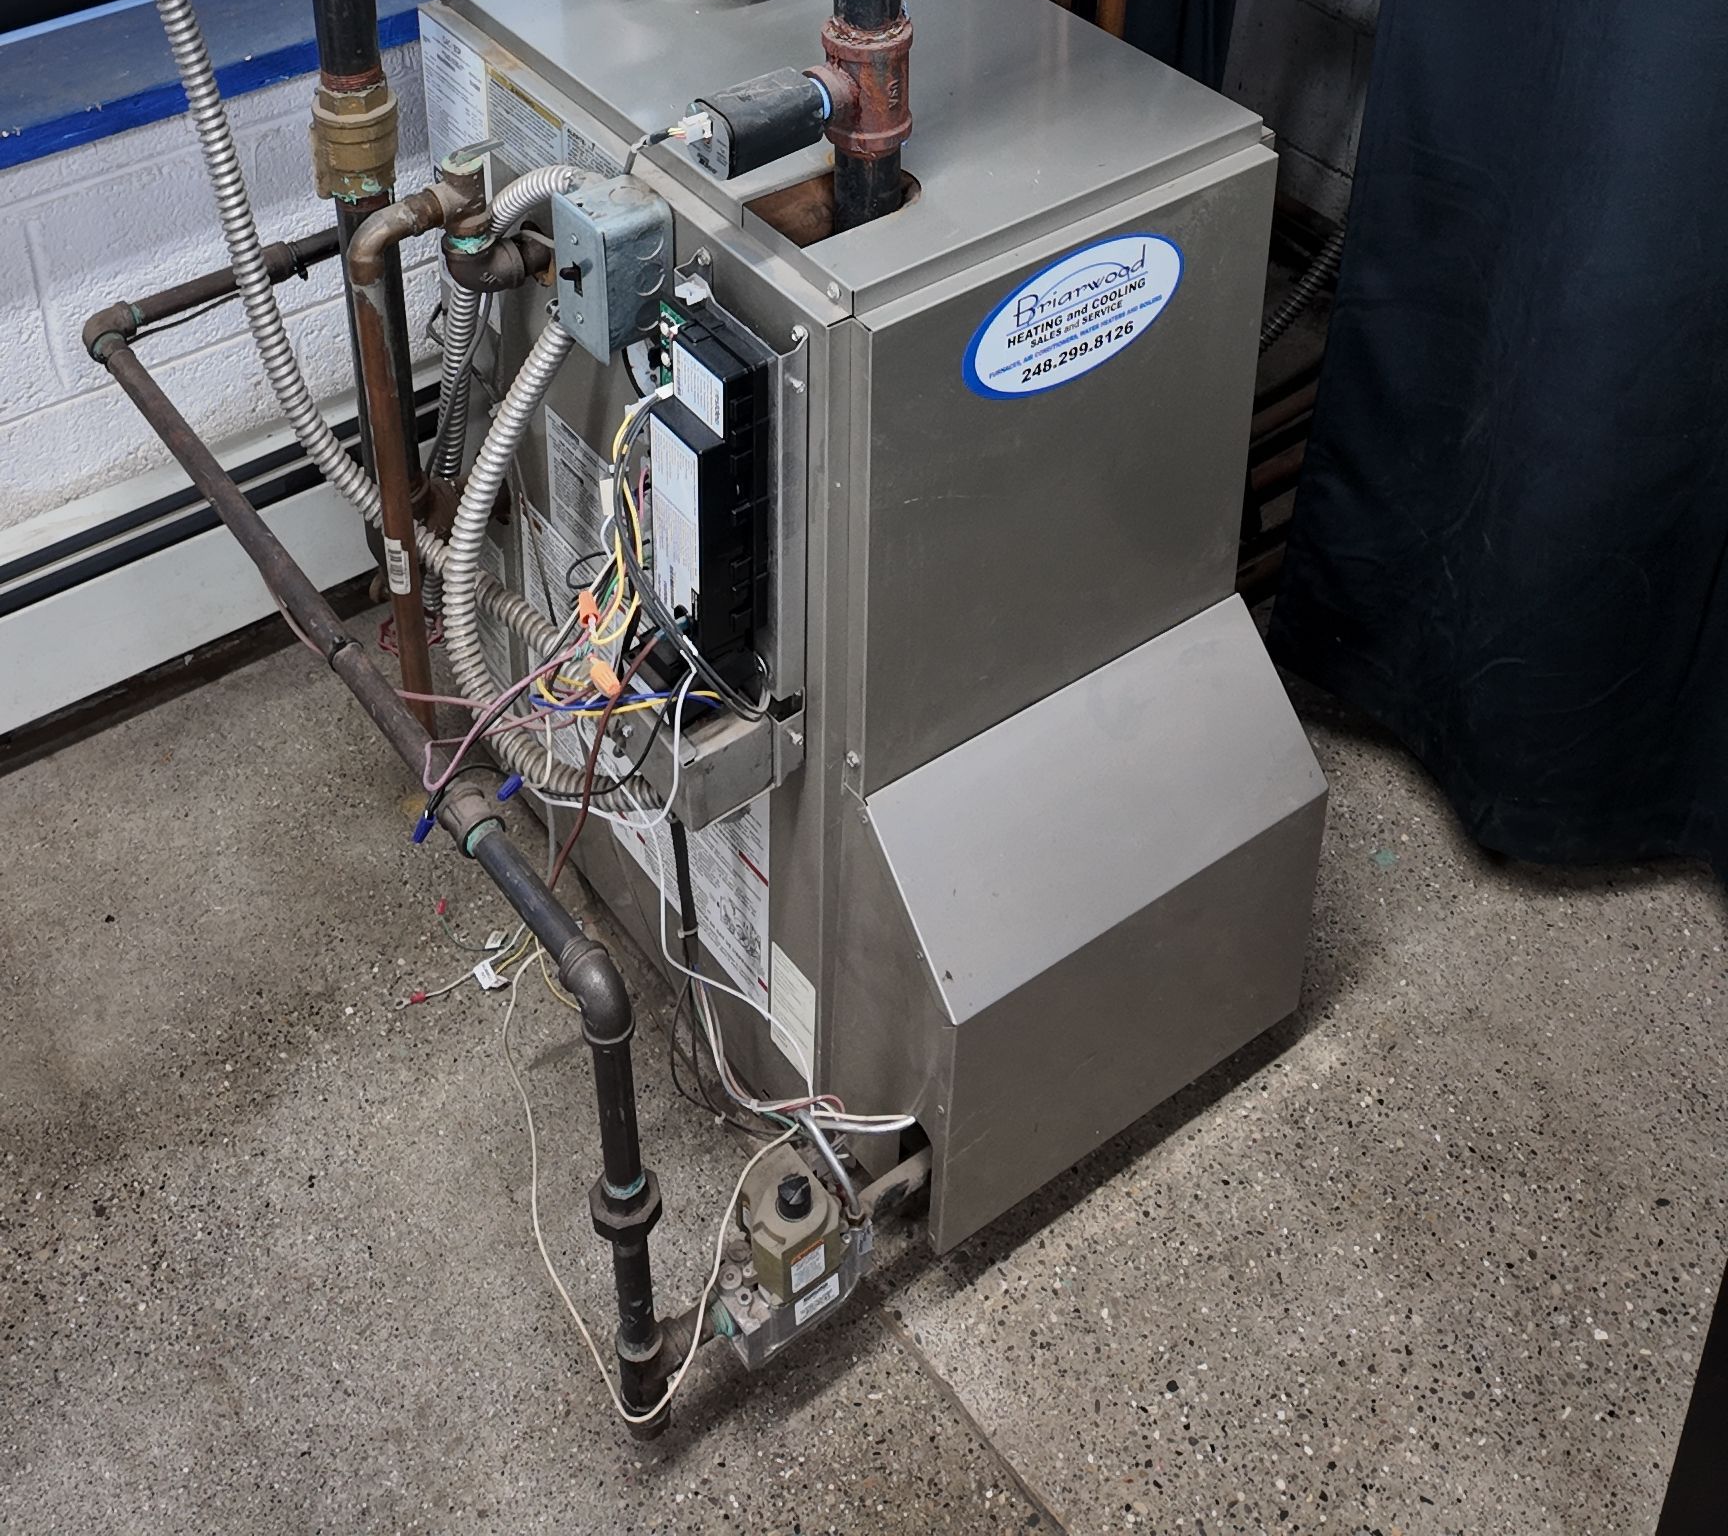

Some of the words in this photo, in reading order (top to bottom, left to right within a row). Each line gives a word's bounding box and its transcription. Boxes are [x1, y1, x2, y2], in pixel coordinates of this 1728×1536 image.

[887, 79, 899, 109] USA
[1007, 314, 1063, 349] HEATING
[1066, 304, 1088, 322] and
[1092, 277, 1147, 309] COOLING
[1013, 243, 1147, 328] Briarwood
[1021, 319, 1134, 384] 248.299.8126
[1030, 328, 1062, 349] SALES
[1064, 321, 1080, 334] and
[1081, 299, 1124, 325] SERVICE
